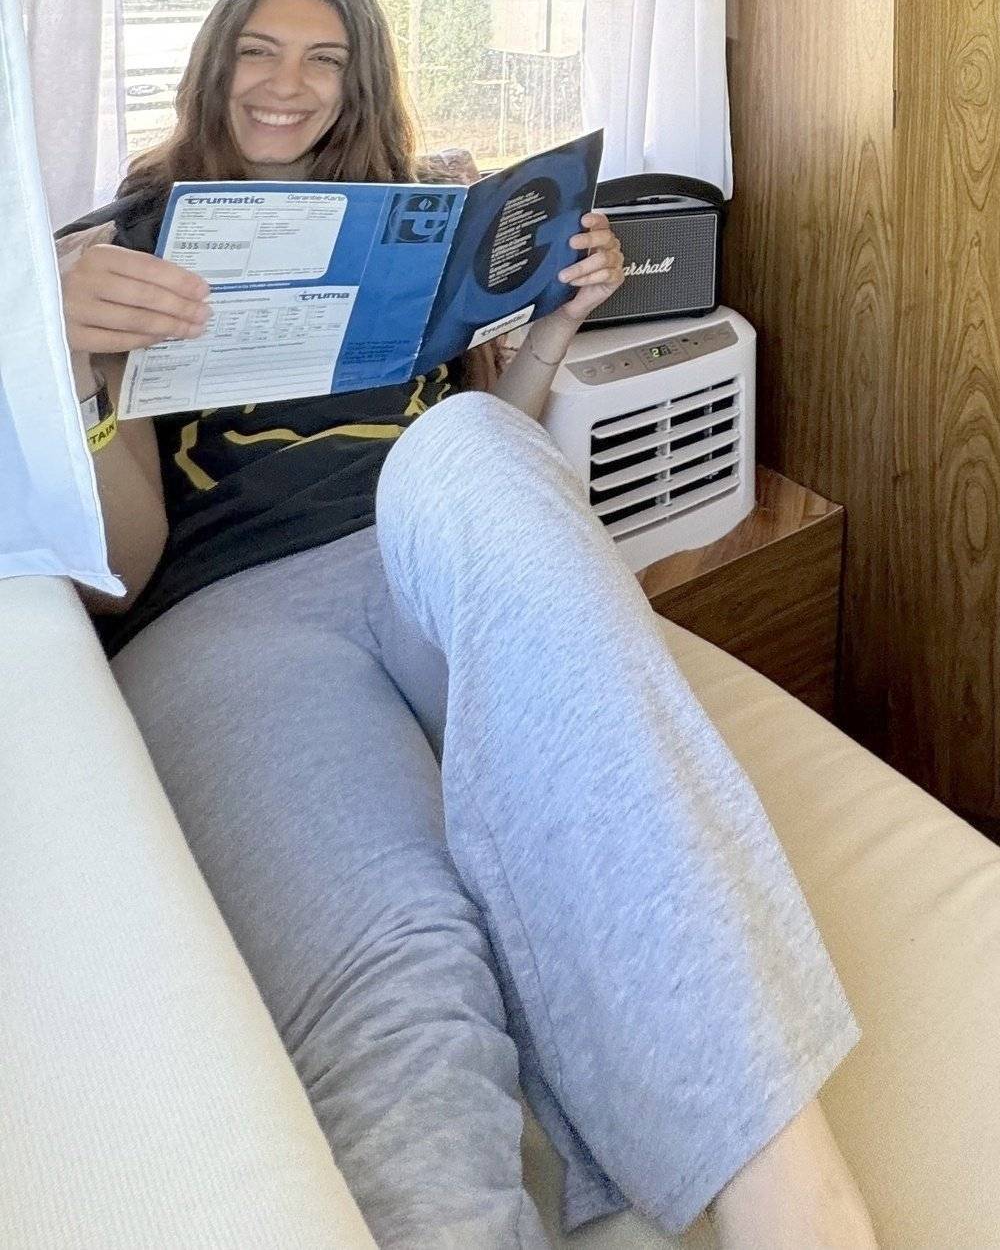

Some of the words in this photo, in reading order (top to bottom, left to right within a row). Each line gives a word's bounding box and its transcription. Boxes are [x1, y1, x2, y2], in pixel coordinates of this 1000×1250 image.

[184, 195, 265, 205] trumatic
[623, 256, 675, 277] arshall
[299, 291, 350, 301] truma
